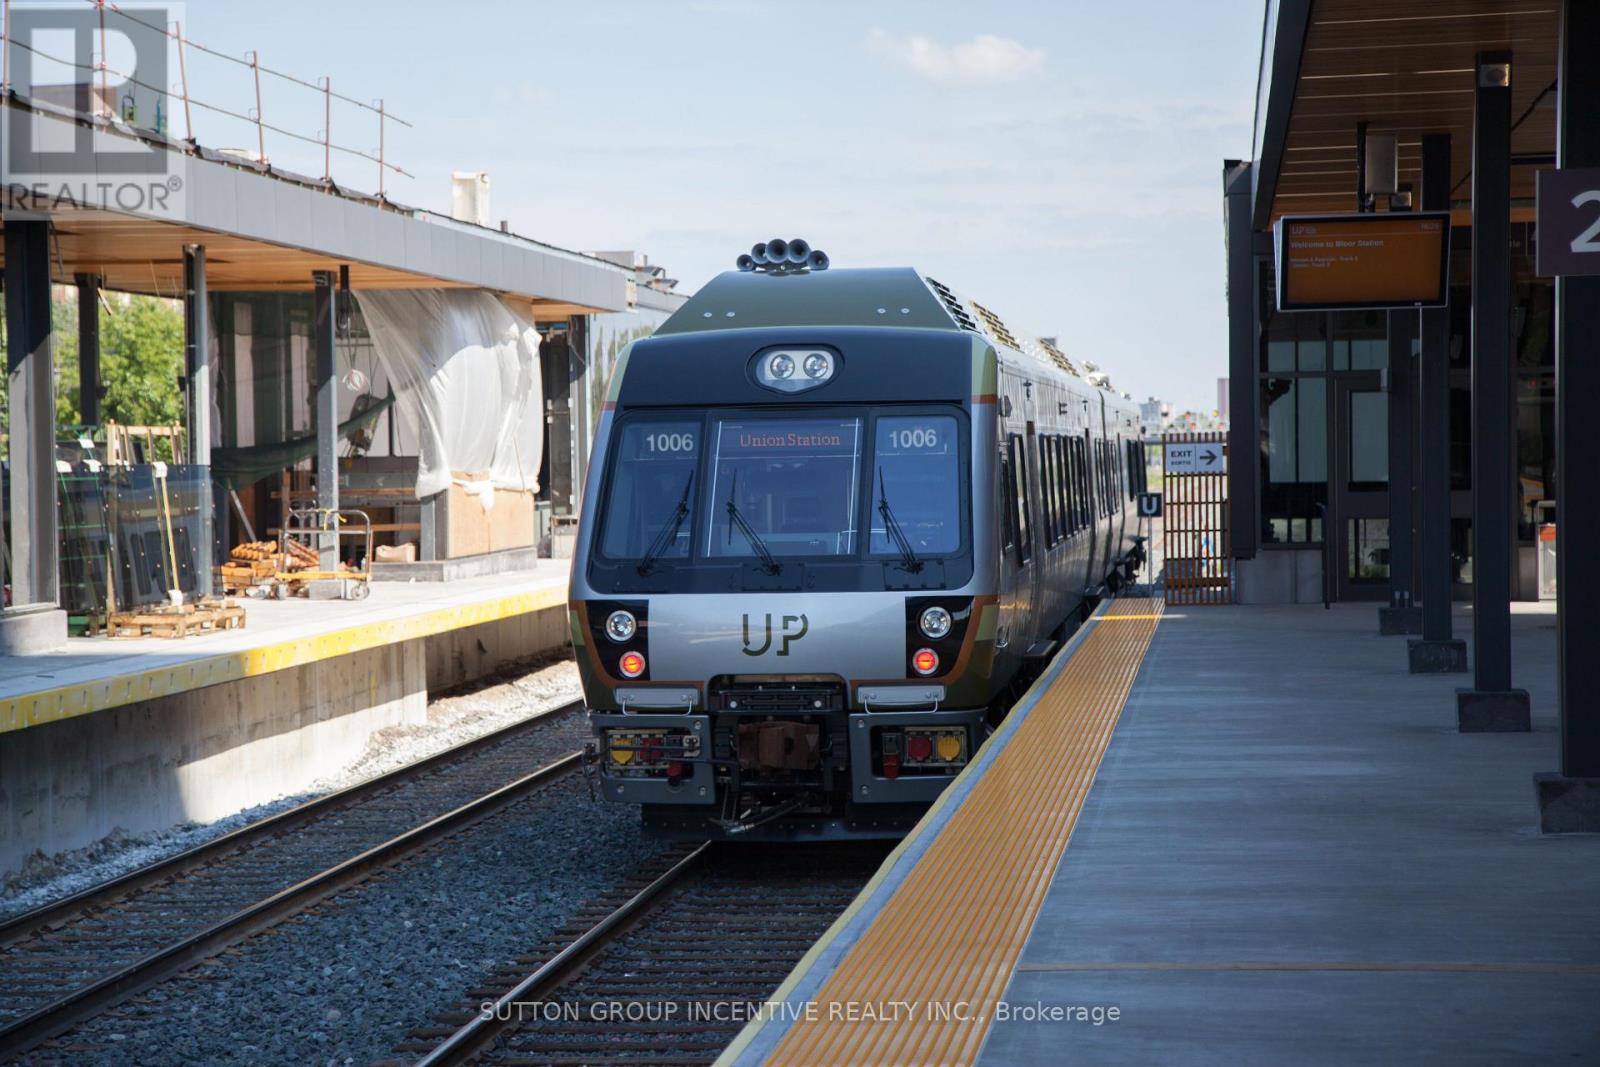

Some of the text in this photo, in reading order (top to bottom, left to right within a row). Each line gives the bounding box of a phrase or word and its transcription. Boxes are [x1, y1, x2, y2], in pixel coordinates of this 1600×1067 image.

[1570, 190, 1600, 253] 2
[1290, 239, 1384, 249] Welcome to Bloor Station
[646, 434, 694, 452] 1006
[740, 433, 840, 447] Union Station
[889, 429, 937, 448] 1006
[1171, 450, 1192, 458] EXIT
[1142, 496, 1158, 515] U
[742, 613, 809, 657] UP
